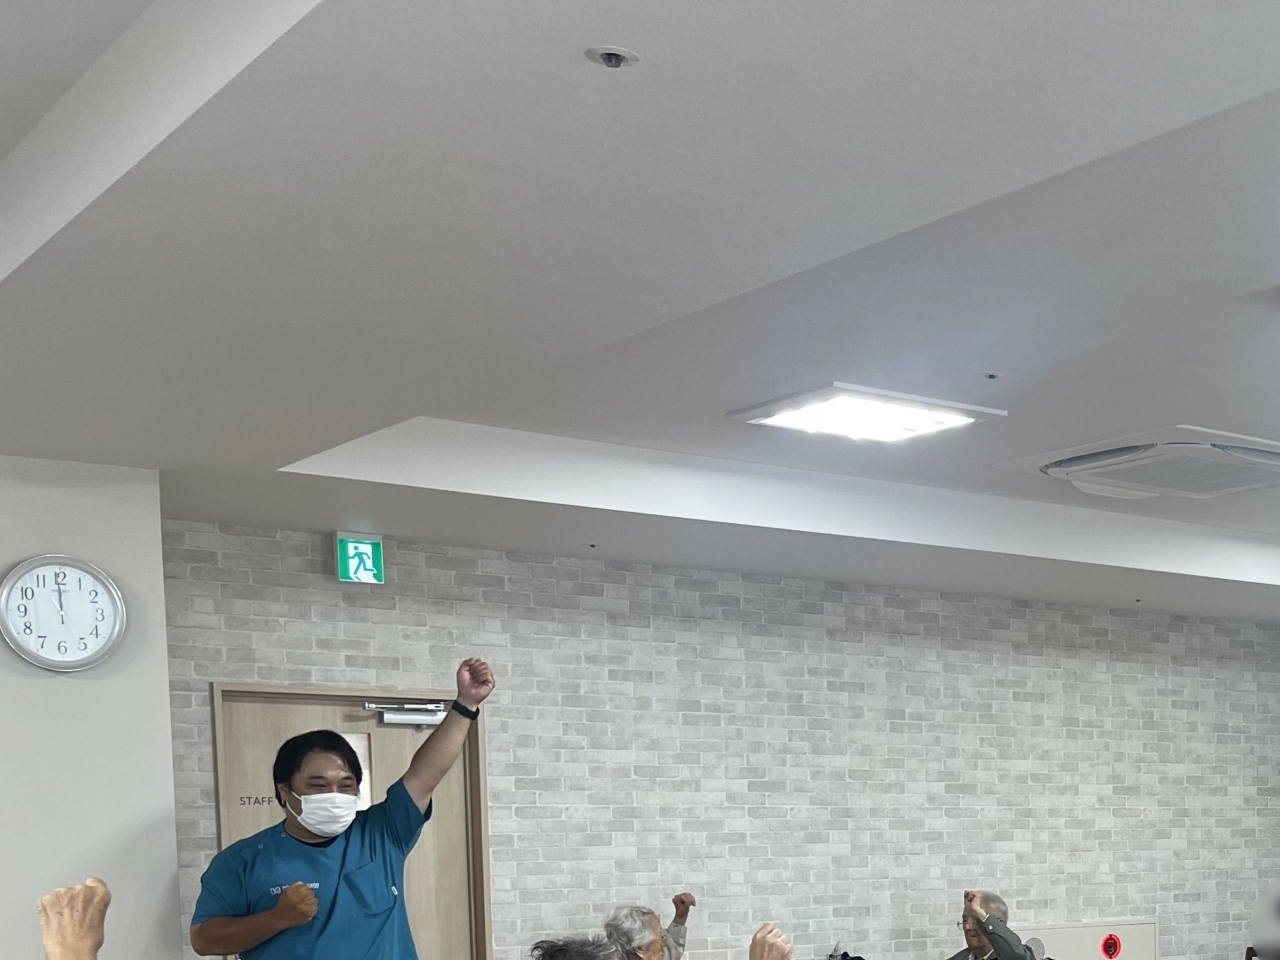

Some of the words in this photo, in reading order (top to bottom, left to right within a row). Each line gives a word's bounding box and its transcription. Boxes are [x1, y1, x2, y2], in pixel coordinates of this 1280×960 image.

[36, 574, 46, 588] 11
[54, 571, 67, 586] 12
[21, 586, 34, 601] 10
[89, 590, 99, 604] 2
[17, 603, 28, 618] 9
[95, 608, 105, 622] 3
[23, 621, 33, 636] 8
[89, 625, 101, 639] 4
[37, 635, 47, 649] 7
[57, 641, 68, 655] 6
[77, 637, 88, 651] 5
[239, 796, 274, 806] STAFF
